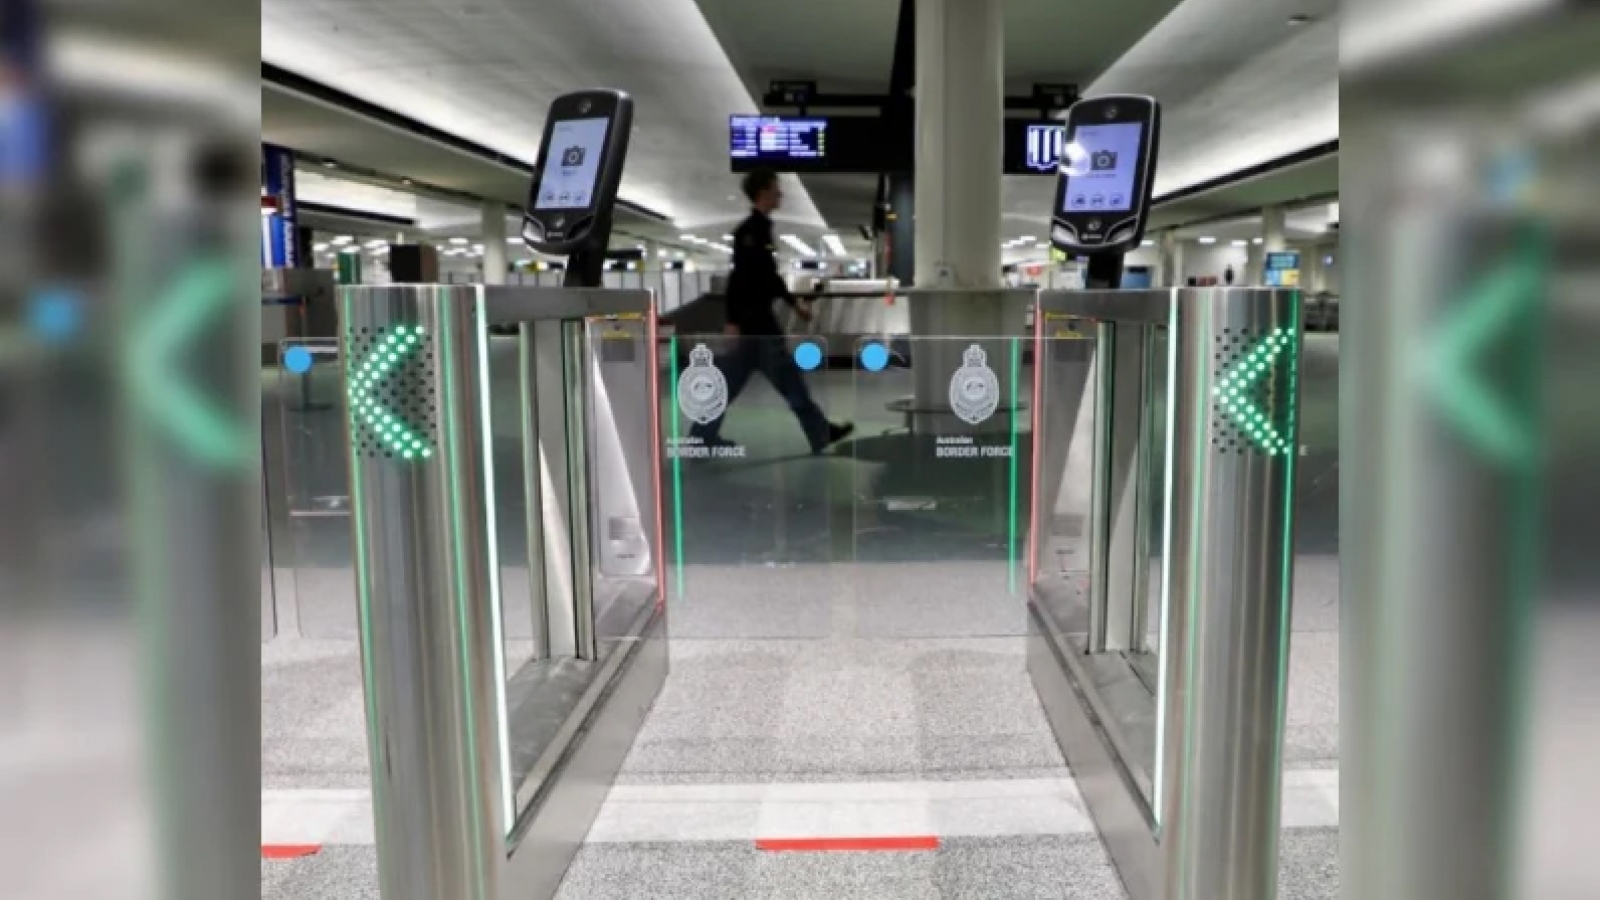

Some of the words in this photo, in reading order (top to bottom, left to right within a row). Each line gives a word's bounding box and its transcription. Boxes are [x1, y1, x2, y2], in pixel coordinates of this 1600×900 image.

[936, 435, 974, 444] Australian
[666, 446, 709, 458] BORDER
[711, 445, 747, 457] FORCE
[936, 446, 979, 458] BORDER
